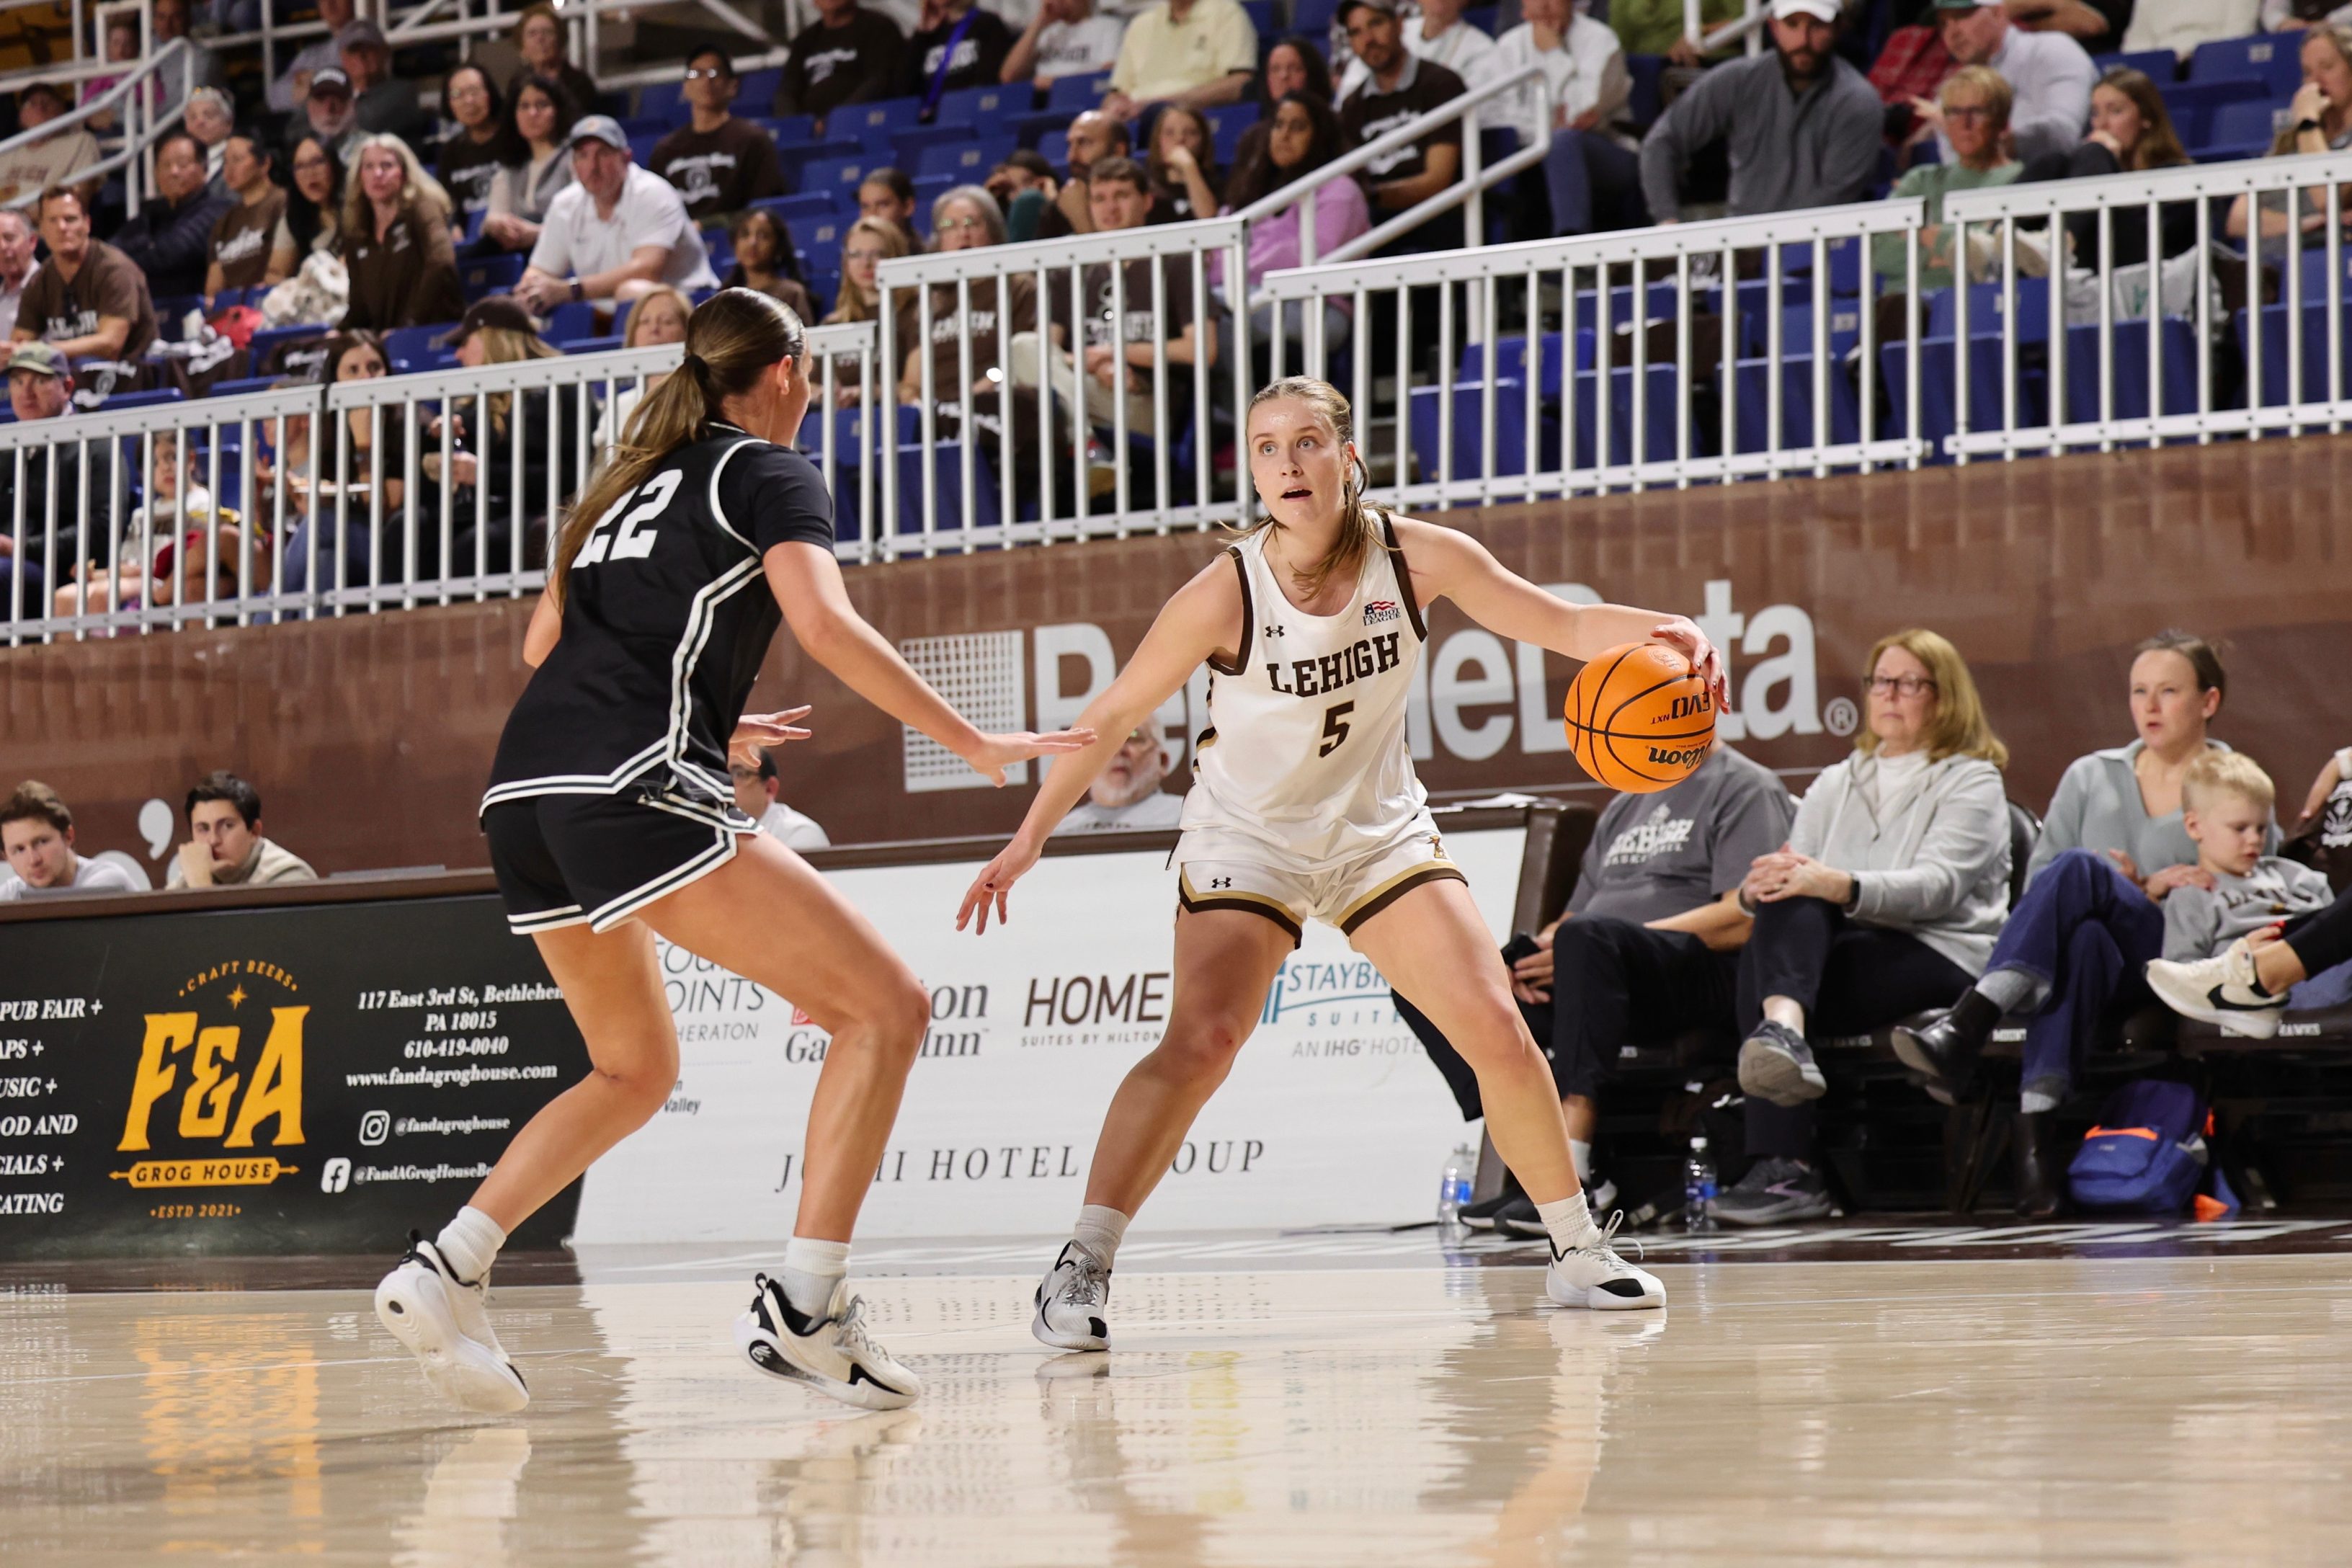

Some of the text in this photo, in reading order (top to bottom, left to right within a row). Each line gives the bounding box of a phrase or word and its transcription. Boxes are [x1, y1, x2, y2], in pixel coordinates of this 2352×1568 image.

[571, 468, 683, 569] 22
[1363, 607, 1401, 621] PATRIOT
[1364, 613, 1402, 626] LEAGUE
[1266, 631, 1400, 698] LEHIGH
[1318, 699, 1355, 758] 5
[1650, 713, 1670, 725] NXT
[187, 959, 293, 992] CRAFT BEERS
[358, 990, 386, 1010] 117
[388, 989, 425, 1008] East
[425, 987, 457, 1007] 3rd
[457, 986, 480, 1008] St,
[664, 978, 765, 1015] OINTS
[1023, 972, 1171, 1027] HOME
[0, 1000, 39, 1021] PUB
[40, 997, 86, 1019] FAIR
[424, 1010, 497, 1032] PA 18015
[677, 1022, 760, 1043] HERATON
[1020, 1031, 1162, 1048] SUITES BY HILTON
[404, 1035, 509, 1059] 610-419-0040
[1291, 1040, 1319, 1058] AN
[116, 1005, 311, 1152] F&A
[346, 1063, 558, 1089] www.fandagroghouse.com
[33, 1114, 79, 1135] AND
[395, 1115, 511, 1137] @fandagroghouse
[927, 1145, 1079, 1181] HOTEL
[1172, 1140, 1265, 1175] OUP
[135, 1163, 273, 1182] GROG HOUSE
[157, 1203, 233, 1219] ESTD 2021
